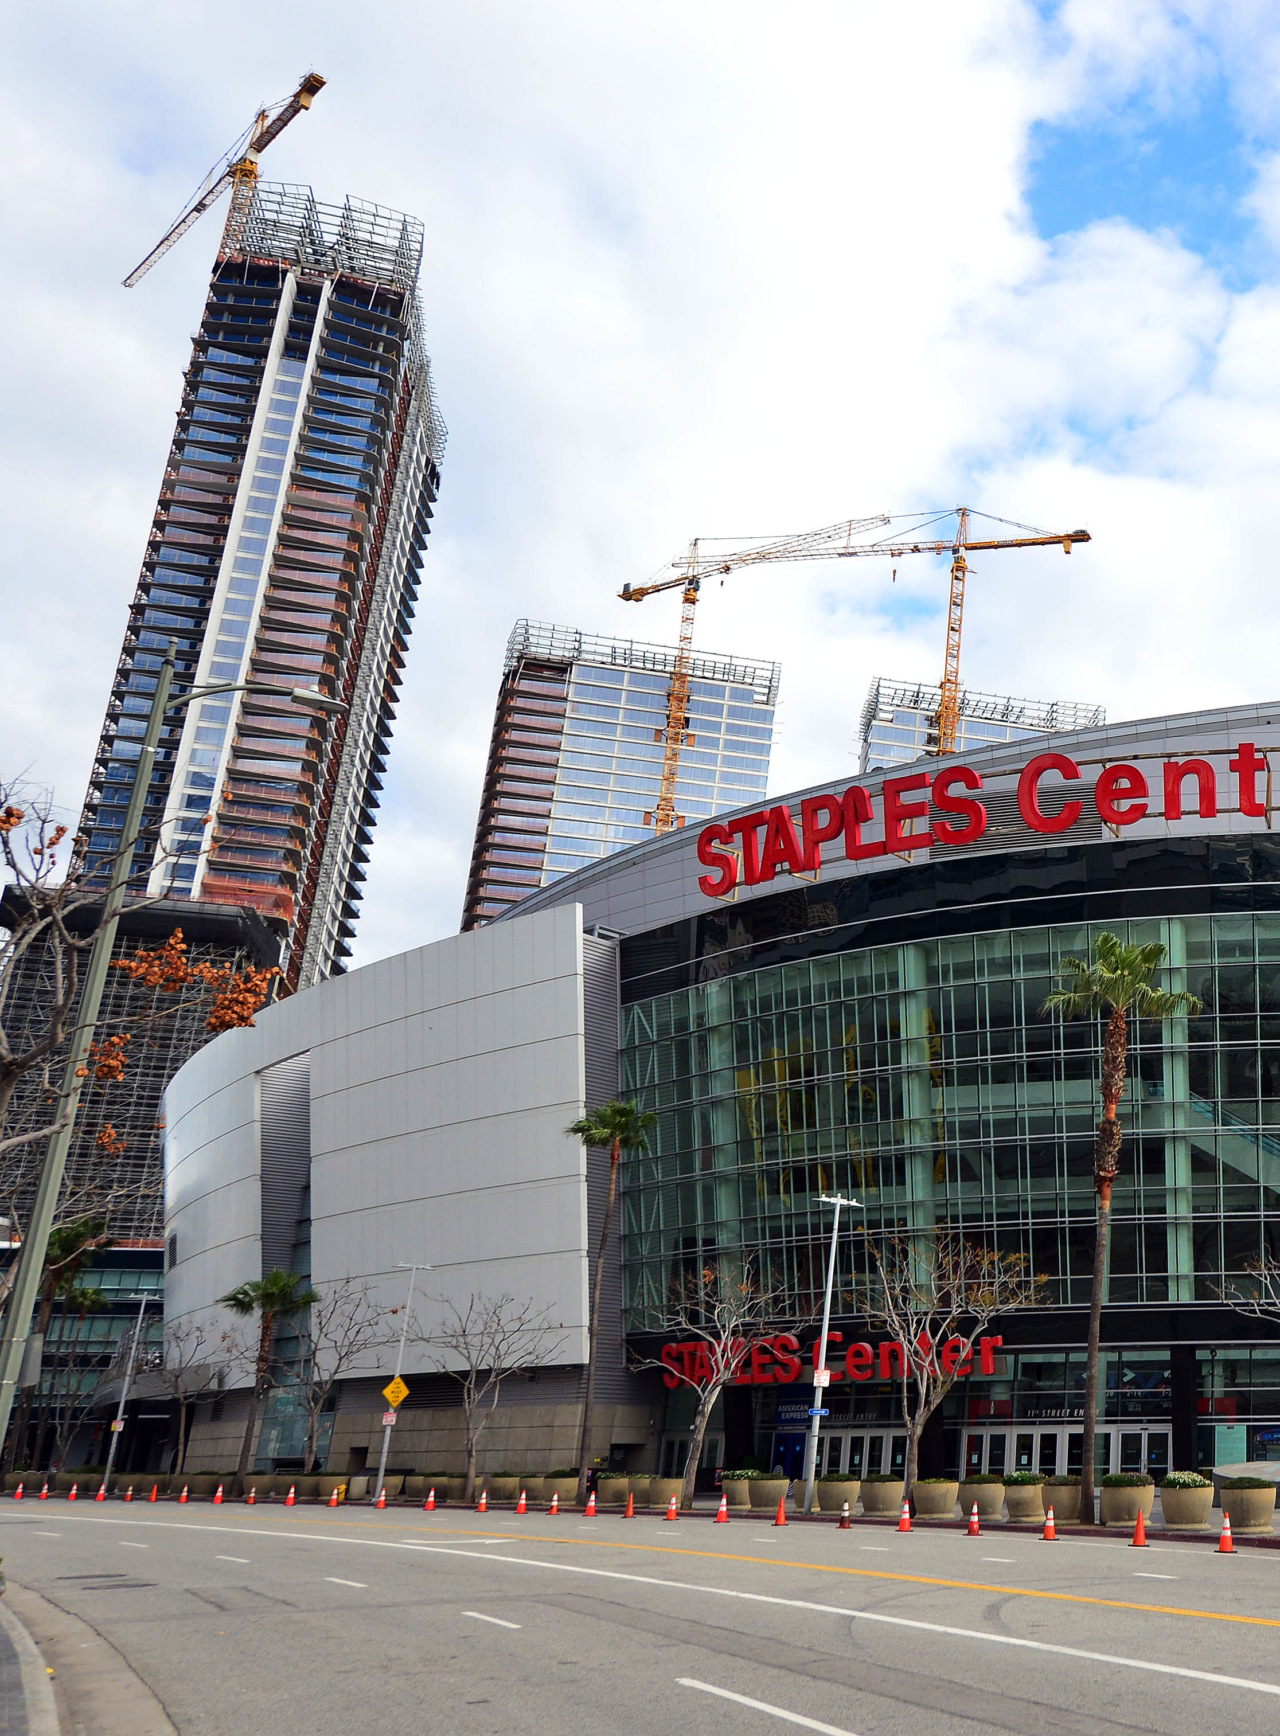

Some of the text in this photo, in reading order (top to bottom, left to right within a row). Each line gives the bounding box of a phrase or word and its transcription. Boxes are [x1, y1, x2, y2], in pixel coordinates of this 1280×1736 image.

[697, 765, 988, 898] STAPLES
[778, 1404, 809, 1412] AMERICAN
[781, 1411, 809, 1419] EXPRESS
[1042, 1409, 1071, 1418] STREET
[1074, 1408, 1100, 1417] ENY
